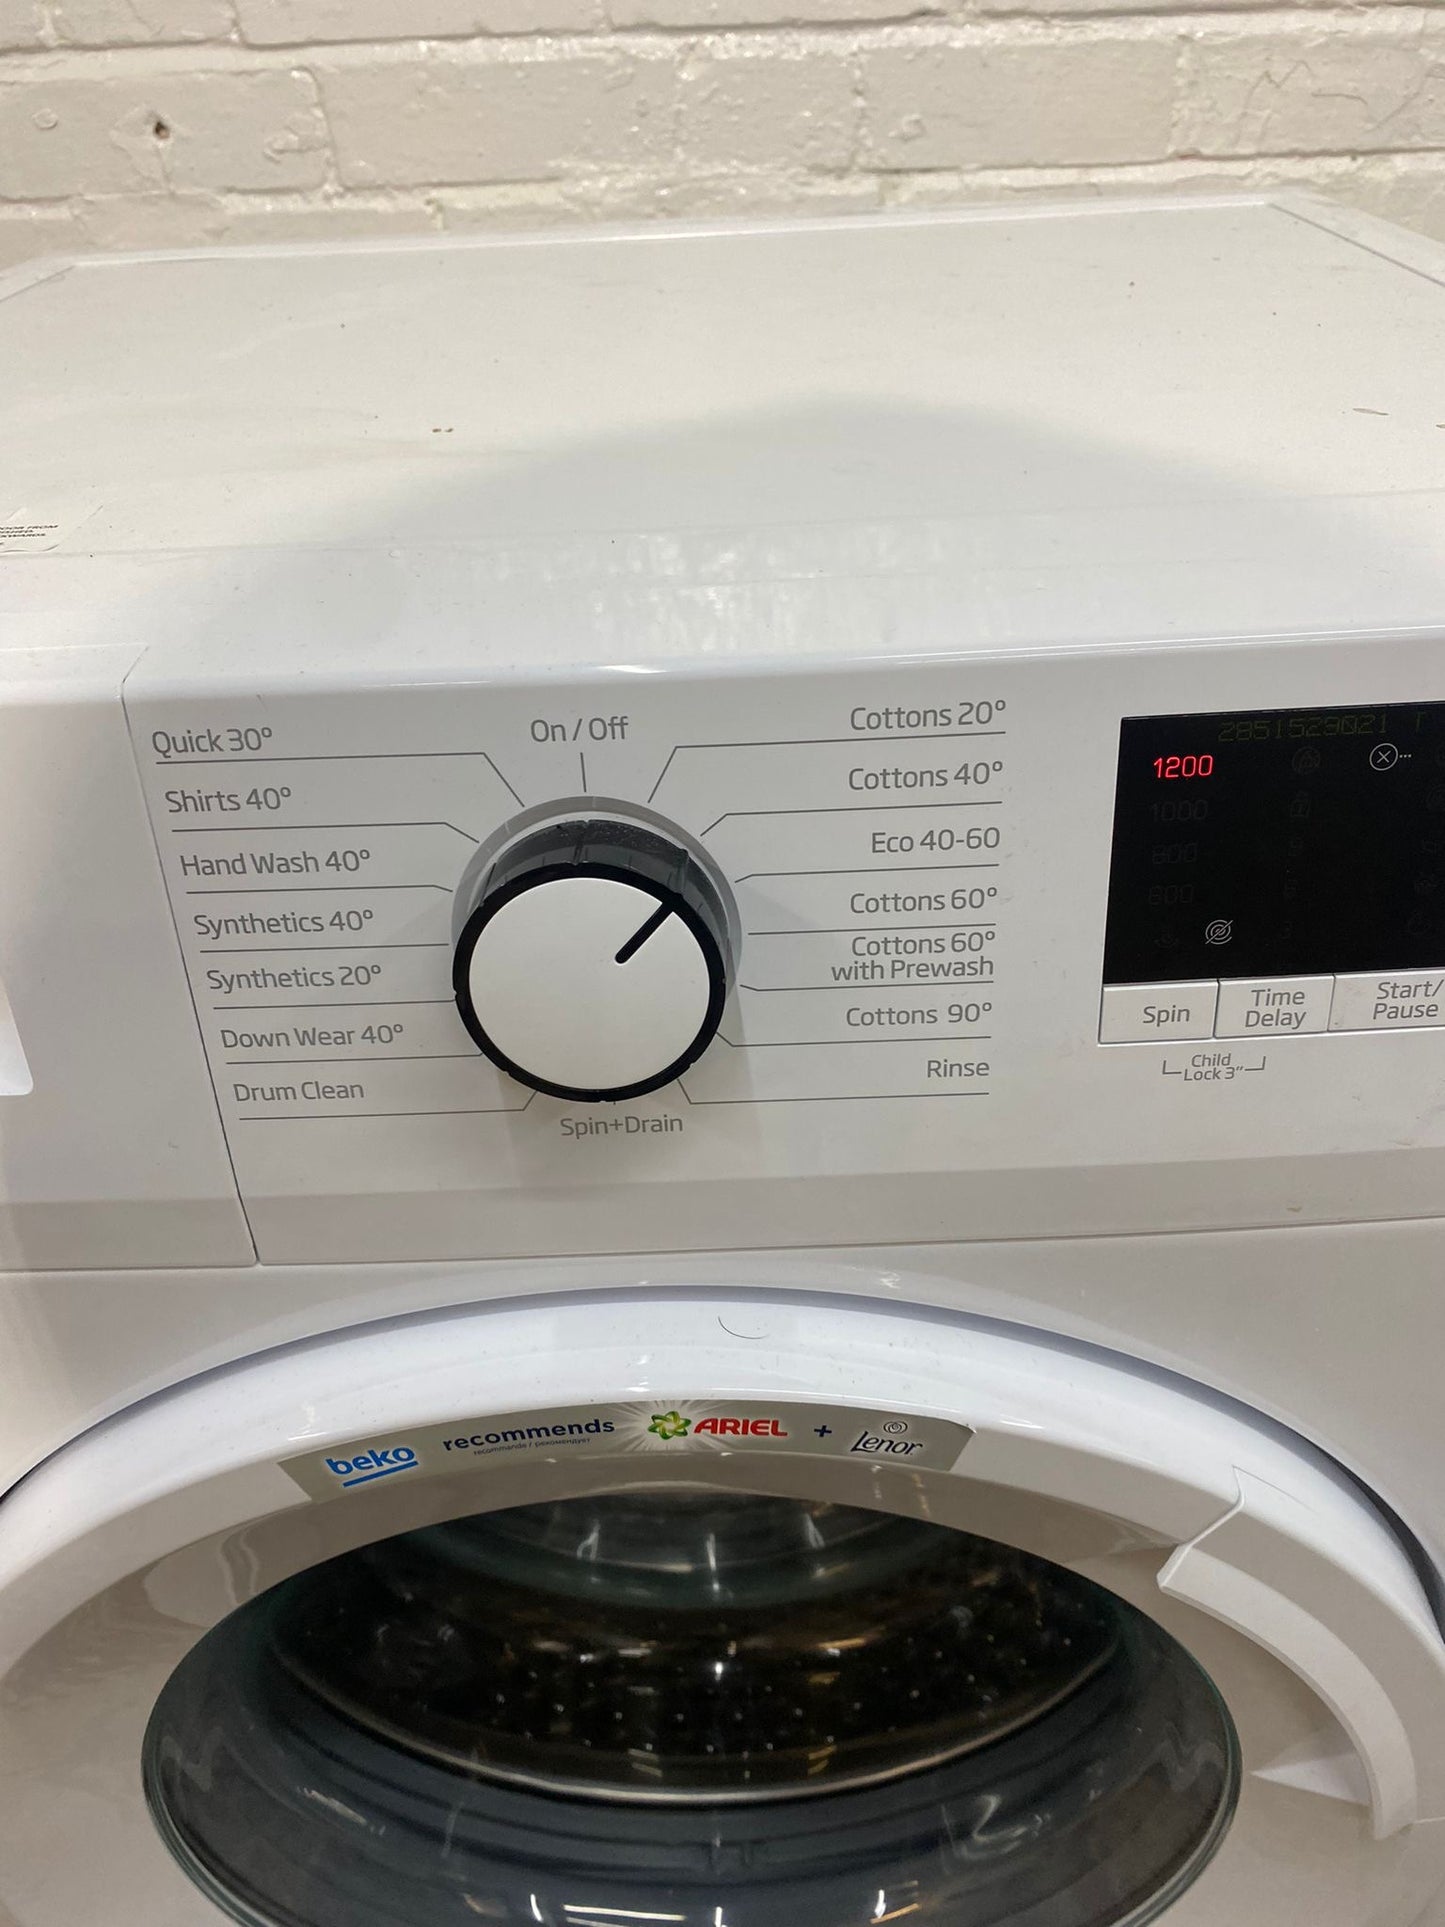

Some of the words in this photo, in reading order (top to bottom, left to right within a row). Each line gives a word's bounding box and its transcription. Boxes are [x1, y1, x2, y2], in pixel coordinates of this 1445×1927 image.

[850, 704, 952, 731] Cottons
[957, 700, 1006, 726] 20°
[530, 720, 566, 743] On
[572, 718, 583, 742] /
[589, 716, 629, 741] Off
[152, 729, 224, 759] Quick
[228, 727, 272, 751] 30°
[848, 766, 948, 791] Cottons
[953, 760, 1003, 786] 40°
[1153, 755, 1213, 778] 1200
[165, 788, 241, 813] Shirts
[246, 786, 292, 810] 40°
[871, 832, 914, 853] Eco
[919, 827, 1001, 851] 40-60
[180, 852, 247, 875] Hand
[250, 850, 319, 874] Wash
[325, 849, 371, 872] 40°
[850, 892, 946, 914] Cottons
[950, 887, 998, 909] 60°
[194, 912, 324, 940] Synthetics
[328, 909, 374, 931] 40°
[851, 934, 946, 956] Cottons
[950, 931, 996, 953] 60°
[206, 968, 334, 994] Synthetics
[338, 965, 382, 986] 20°
[831, 961, 884, 982] with
[890, 956, 994, 979] Prewash
[1251, 989, 1305, 1007] Time
[1377, 980, 1444, 999] Start/
[846, 1006, 938, 1027] Cottons
[947, 1002, 993, 1024] 90°
[1143, 1005, 1191, 1027] Spin
[1245, 1010, 1307, 1030] Delay
[1373, 1003, 1438, 1020] Pause
[220, 1029, 290, 1048] Down
[294, 1026, 355, 1046] Wear
[361, 1023, 404, 1044] 40°
[926, 1060, 990, 1078] Rinse
[1191, 1053, 1231, 1068] Child
[1183, 1068, 1223, 1081] Lock
[233, 1082, 297, 1102] Drum
[301, 1081, 364, 1100] Clean
[560, 1114, 683, 1139] Spin+Drain
[325, 1447, 415, 1475] beko
[443, 1419, 615, 1451] recommends
[694, 1418, 788, 1436] ARIEL
[851, 1431, 923, 1456] Lenor
[474, 1442, 527, 1455] recommande
